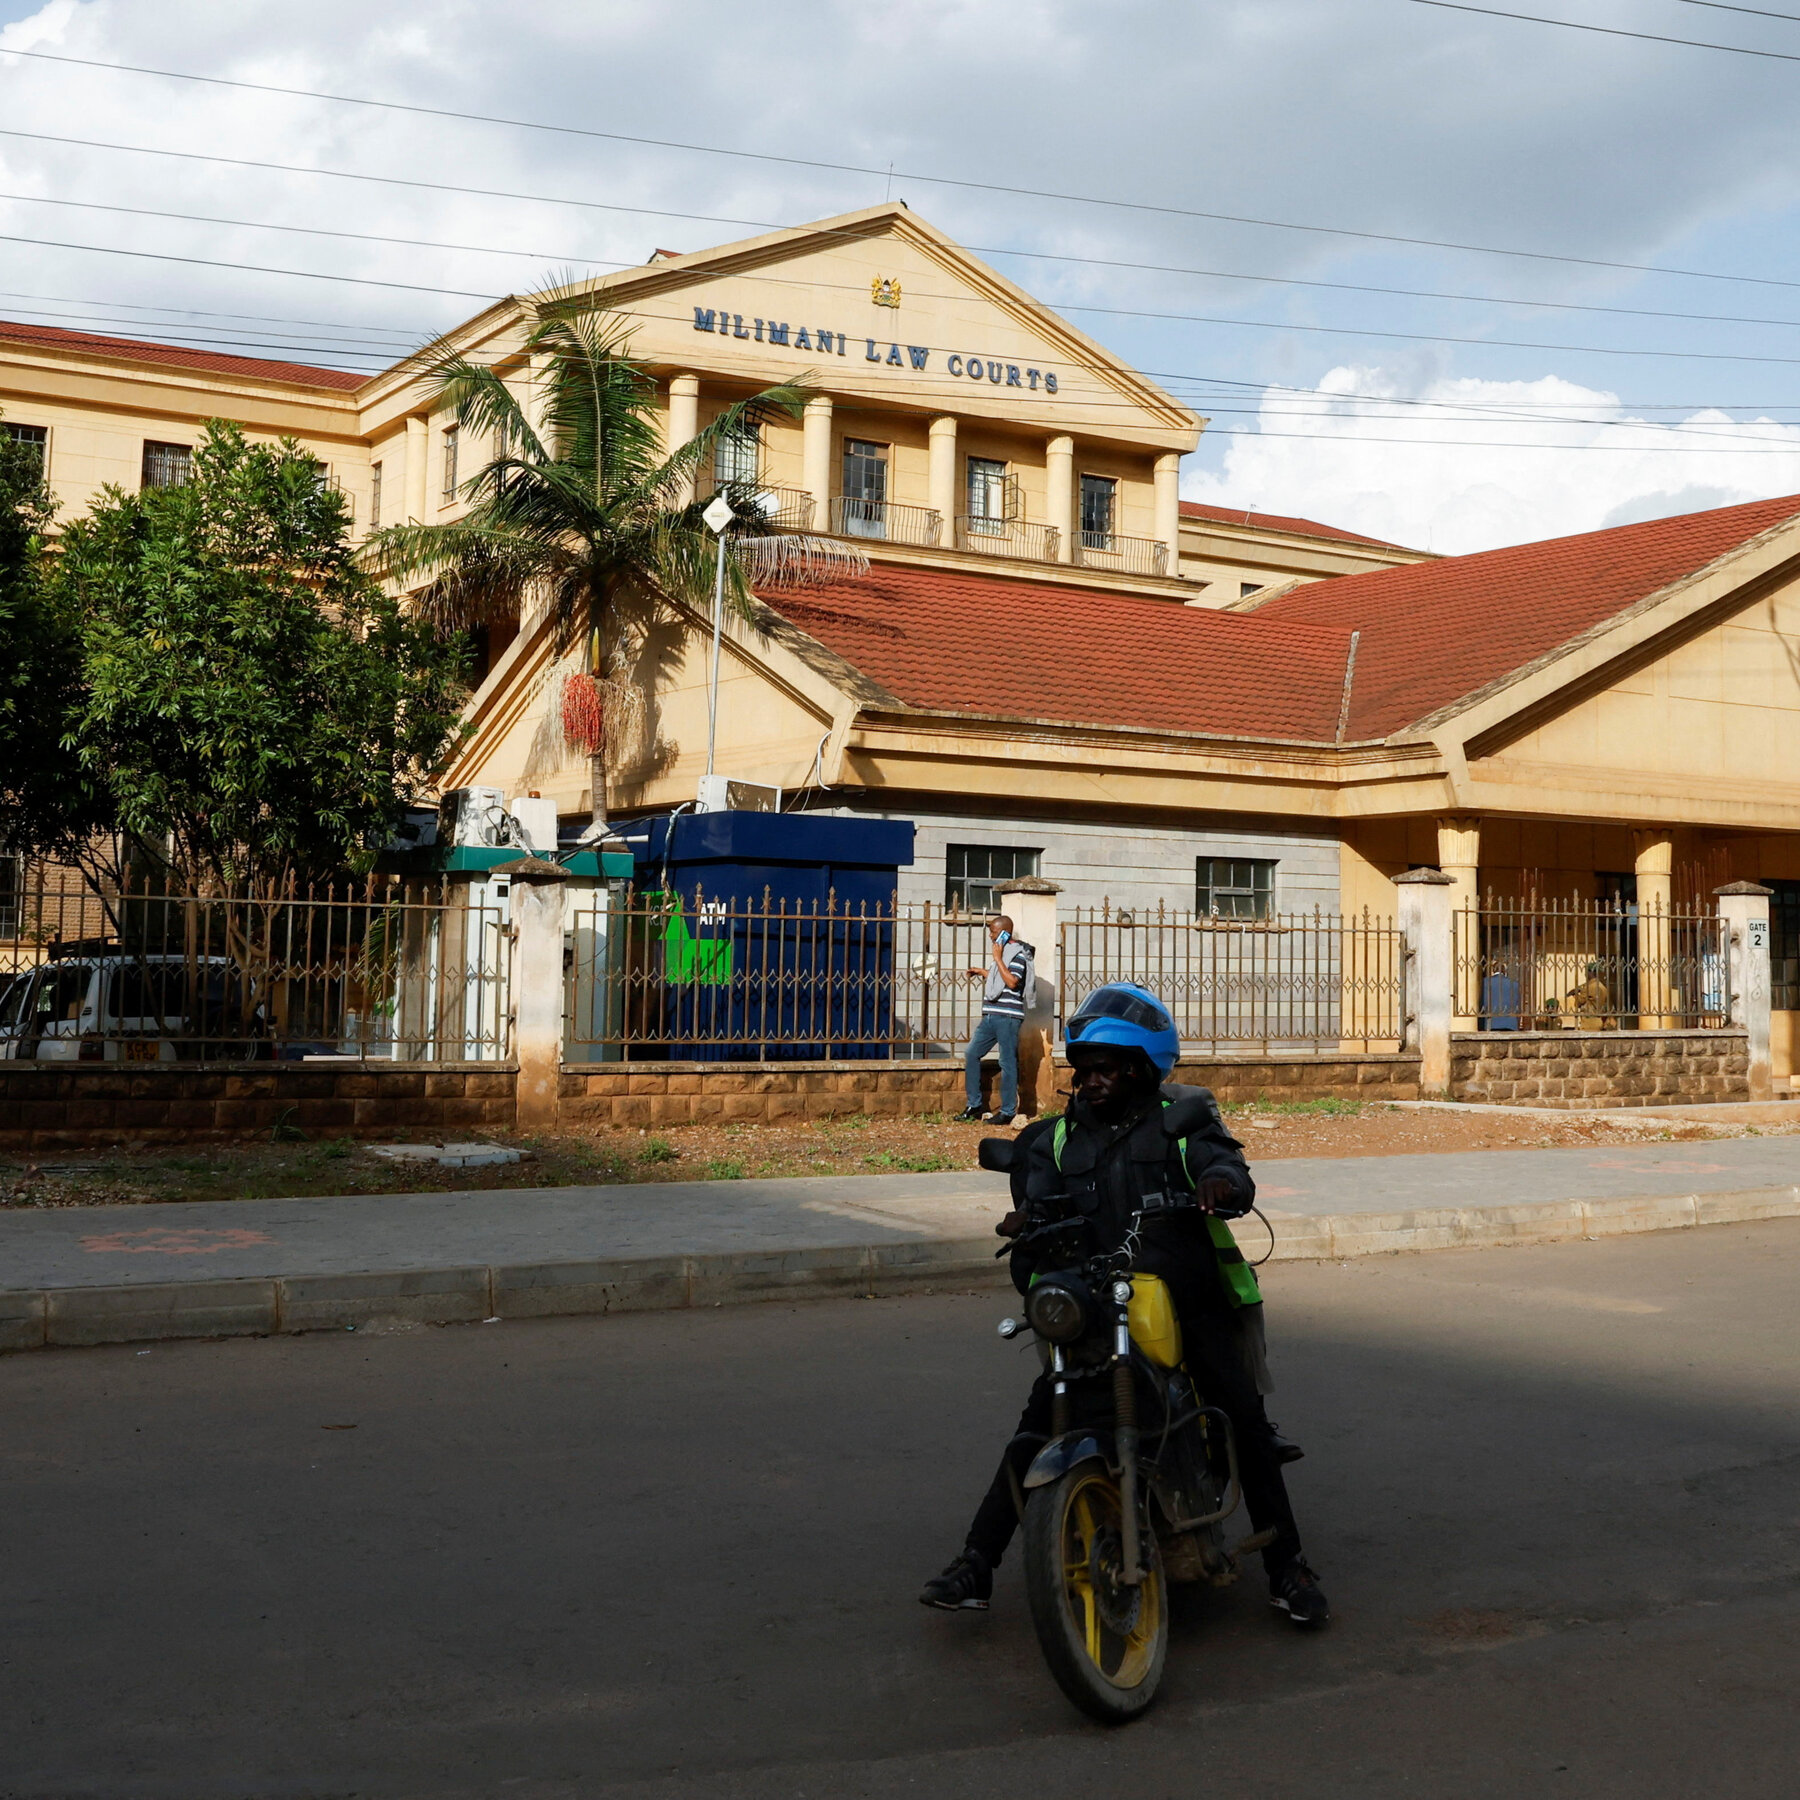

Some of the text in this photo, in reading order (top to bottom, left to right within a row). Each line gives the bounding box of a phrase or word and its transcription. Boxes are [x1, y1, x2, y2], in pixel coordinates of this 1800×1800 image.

[693, 306, 1059, 394] MILIMANI LAW COURTS
[699, 902, 727, 925] ATM
[1749, 923, 1767, 932] GATE
[1754, 934, 1762, 946] 2
